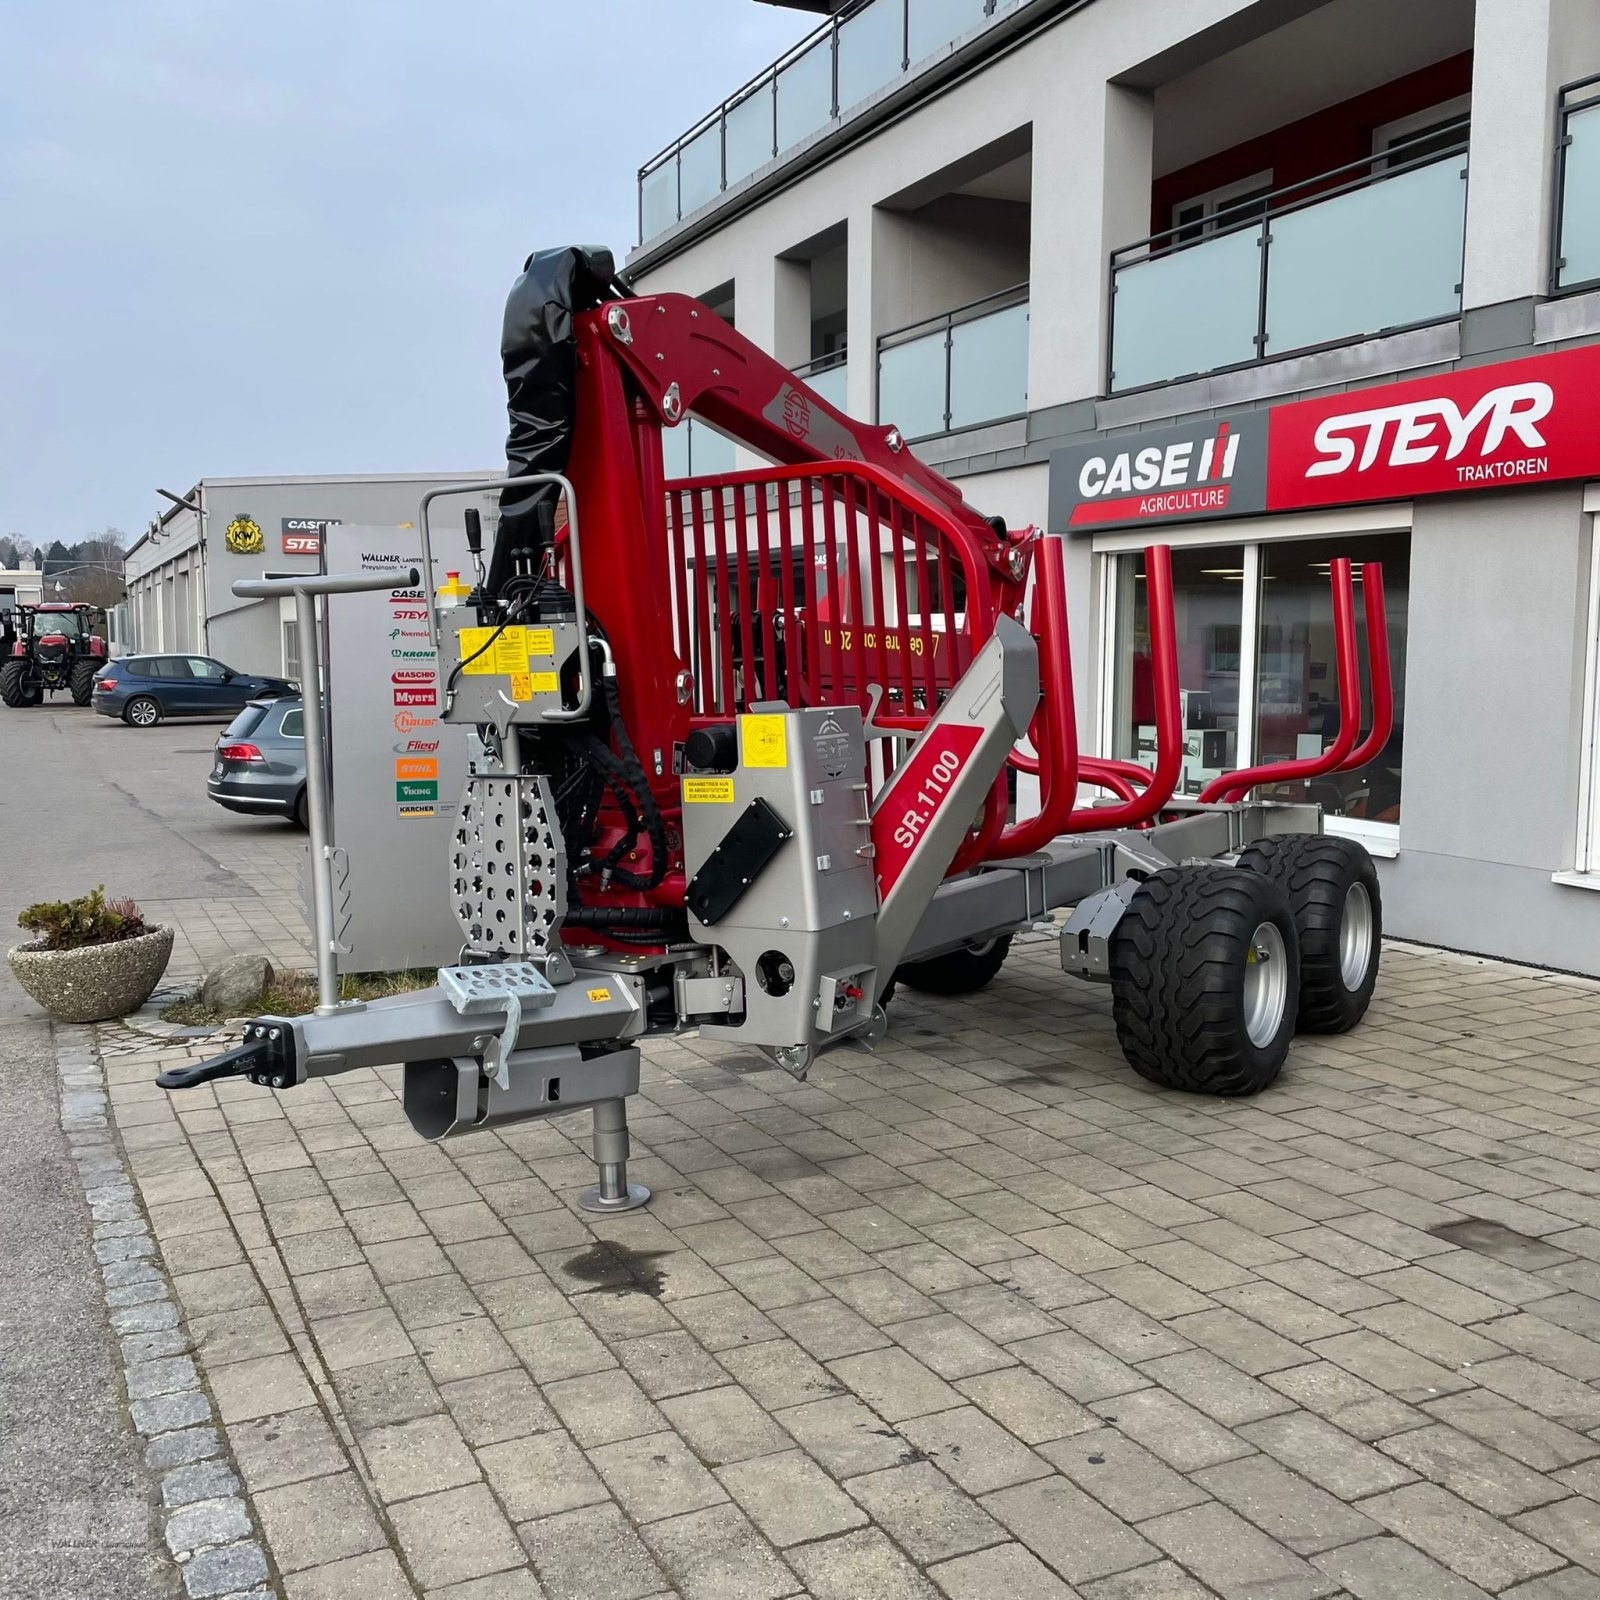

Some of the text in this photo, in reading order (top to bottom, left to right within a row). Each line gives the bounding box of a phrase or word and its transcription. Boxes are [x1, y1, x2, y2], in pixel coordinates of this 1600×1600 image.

[1304, 381, 1555, 478] STEYR
[1078, 420, 1241, 498] CASE IH
[1456, 457, 1548, 482] TRAKTOREN
[1138, 489, 1225, 514] AGRICULTURE
[234, 531, 253, 543] KW
[285, 538, 319, 550] STE
[361, 551, 400, 564] WALLNER
[391, 590, 425, 598] CASE
[397, 671, 436, 679] MASCHIO
[395, 692, 435, 704] Myers
[401, 716, 438, 726] hauer
[407, 740, 440, 752] Fliegl
[402, 786, 432, 796] VIKING
[894, 750, 960, 849] SR.1100
